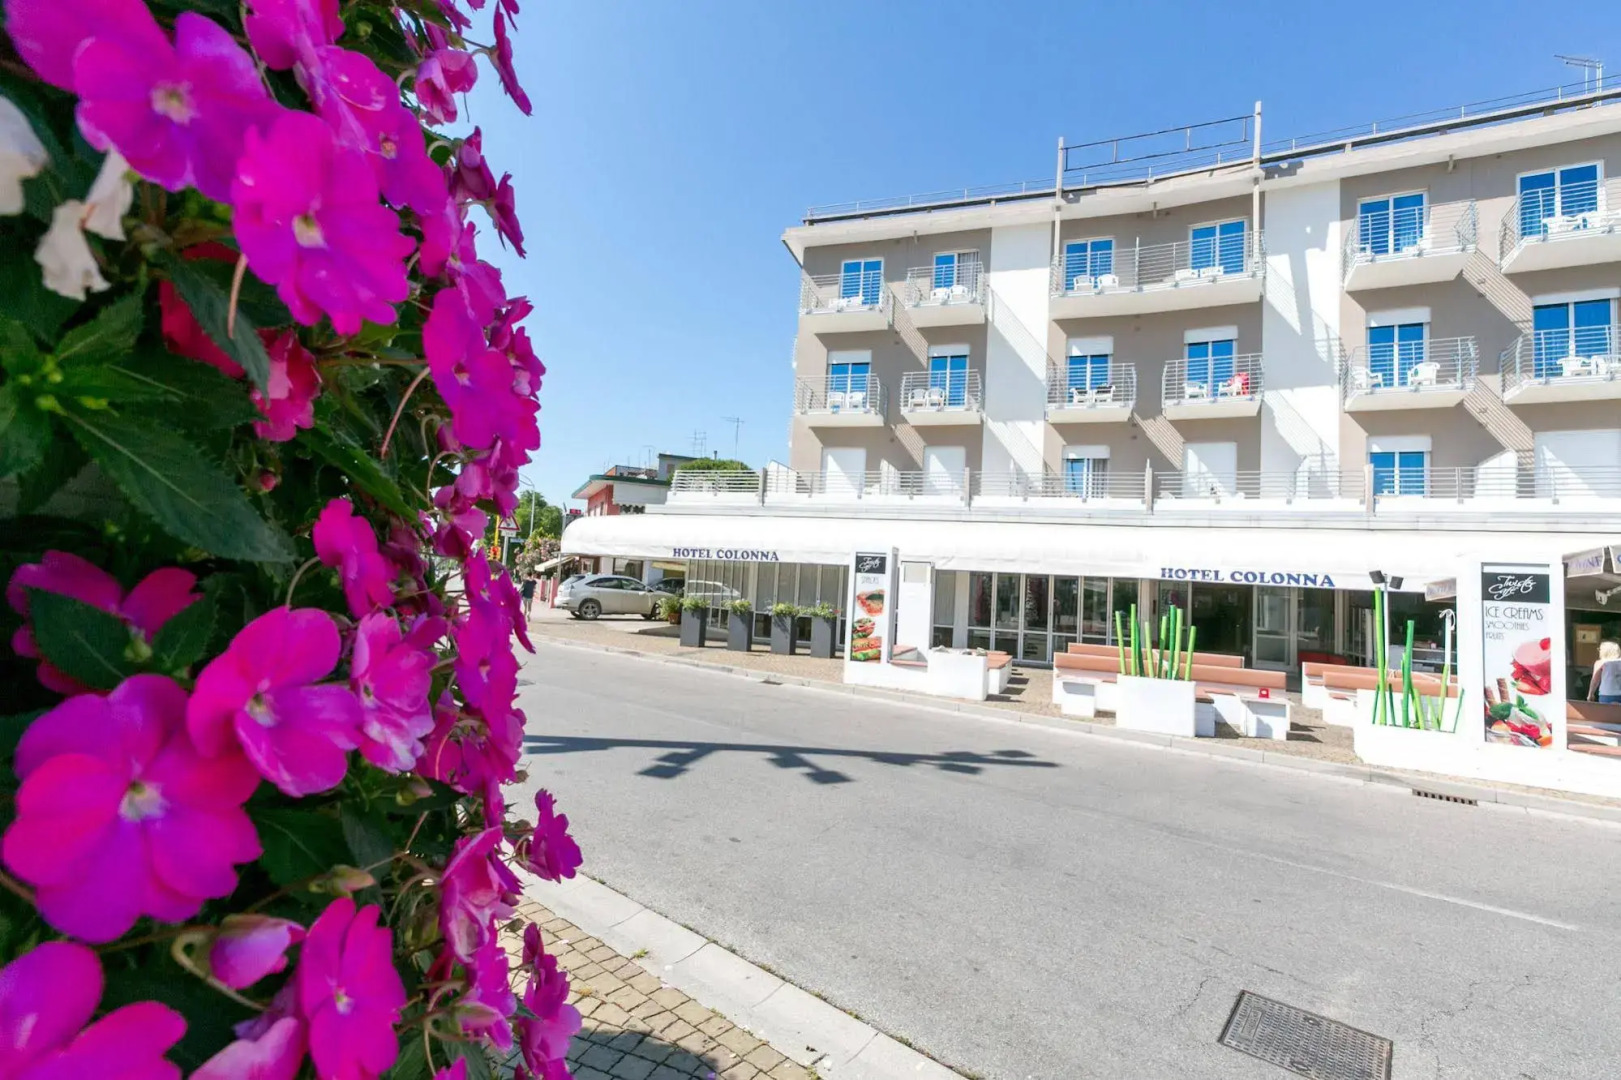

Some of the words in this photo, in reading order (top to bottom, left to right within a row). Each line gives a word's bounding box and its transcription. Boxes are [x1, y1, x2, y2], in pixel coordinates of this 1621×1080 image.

[673, 548, 713, 559] HOTEL
[716, 549, 780, 561] COLONNA
[1160, 567, 1225, 582] HOTEL
[1229, 570, 1336, 587] COLONNA
[1485, 606, 1500, 618] ICE
[1503, 607, 1543, 620] CREAMS
